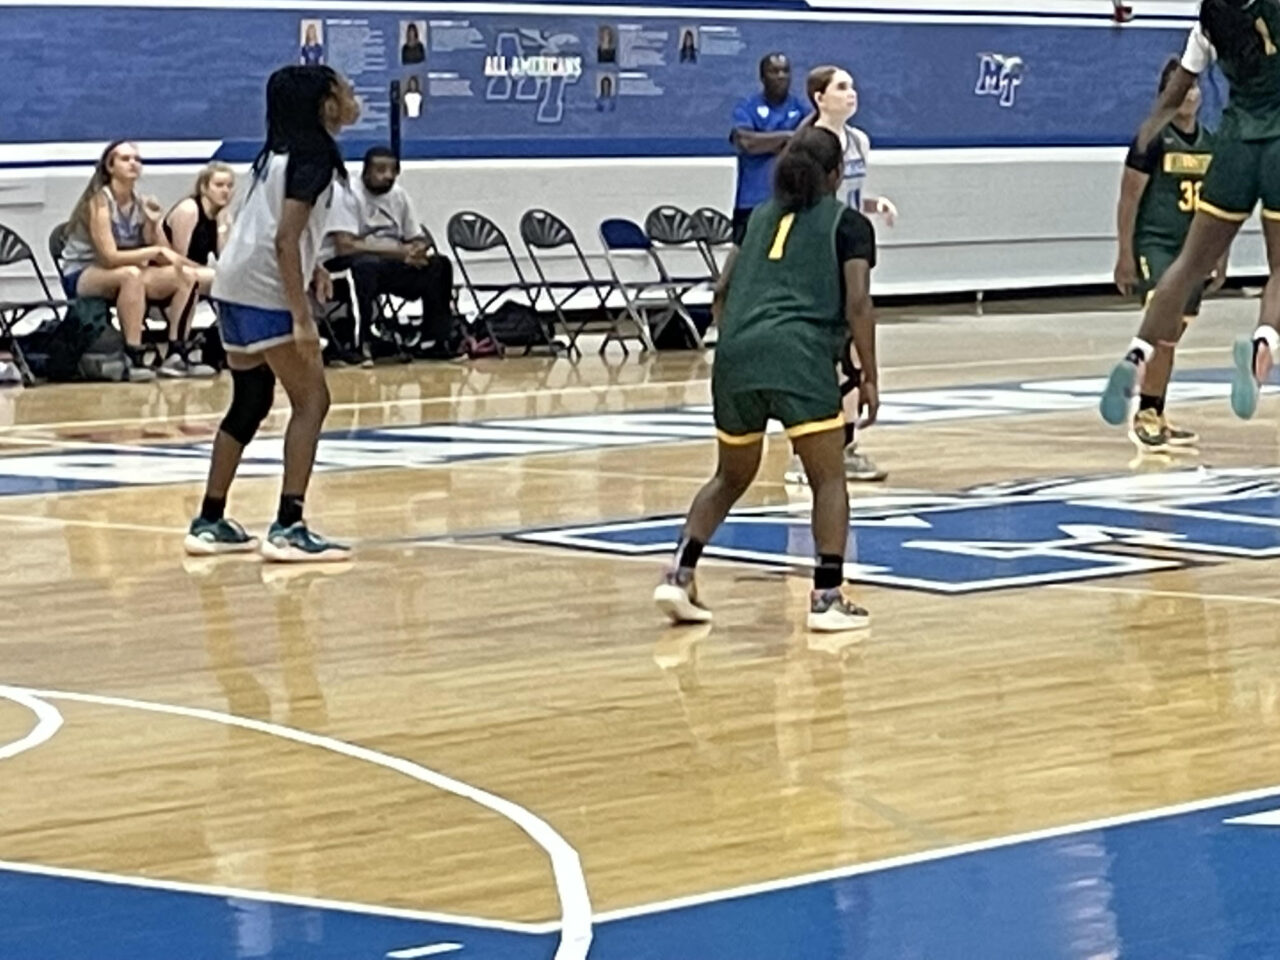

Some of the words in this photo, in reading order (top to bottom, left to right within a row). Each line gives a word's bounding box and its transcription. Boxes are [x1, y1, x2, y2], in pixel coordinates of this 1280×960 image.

[484, 55, 509, 77] ALL
[510, 55, 583, 78] AMERICANS
[767, 212, 796, 261] 1
